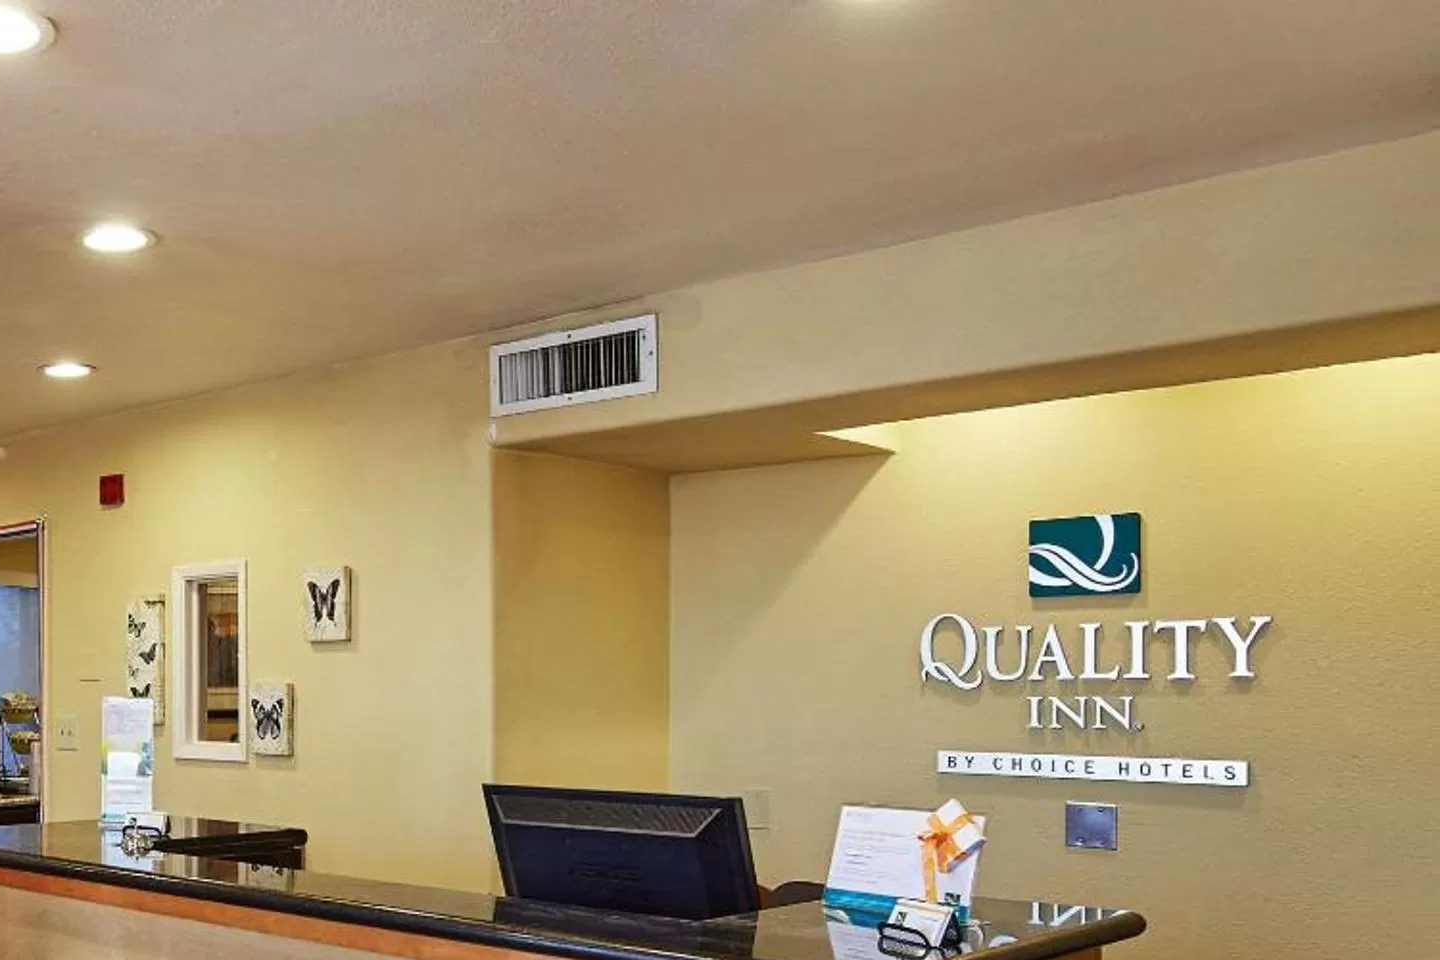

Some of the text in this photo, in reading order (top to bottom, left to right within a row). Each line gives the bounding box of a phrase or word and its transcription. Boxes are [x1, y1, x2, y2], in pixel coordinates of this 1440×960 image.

[920, 613, 1272, 690] QUALITY
[1026, 696, 1134, 730] INN
[946, 755, 1238, 782] BY CHOICE HOTELS
